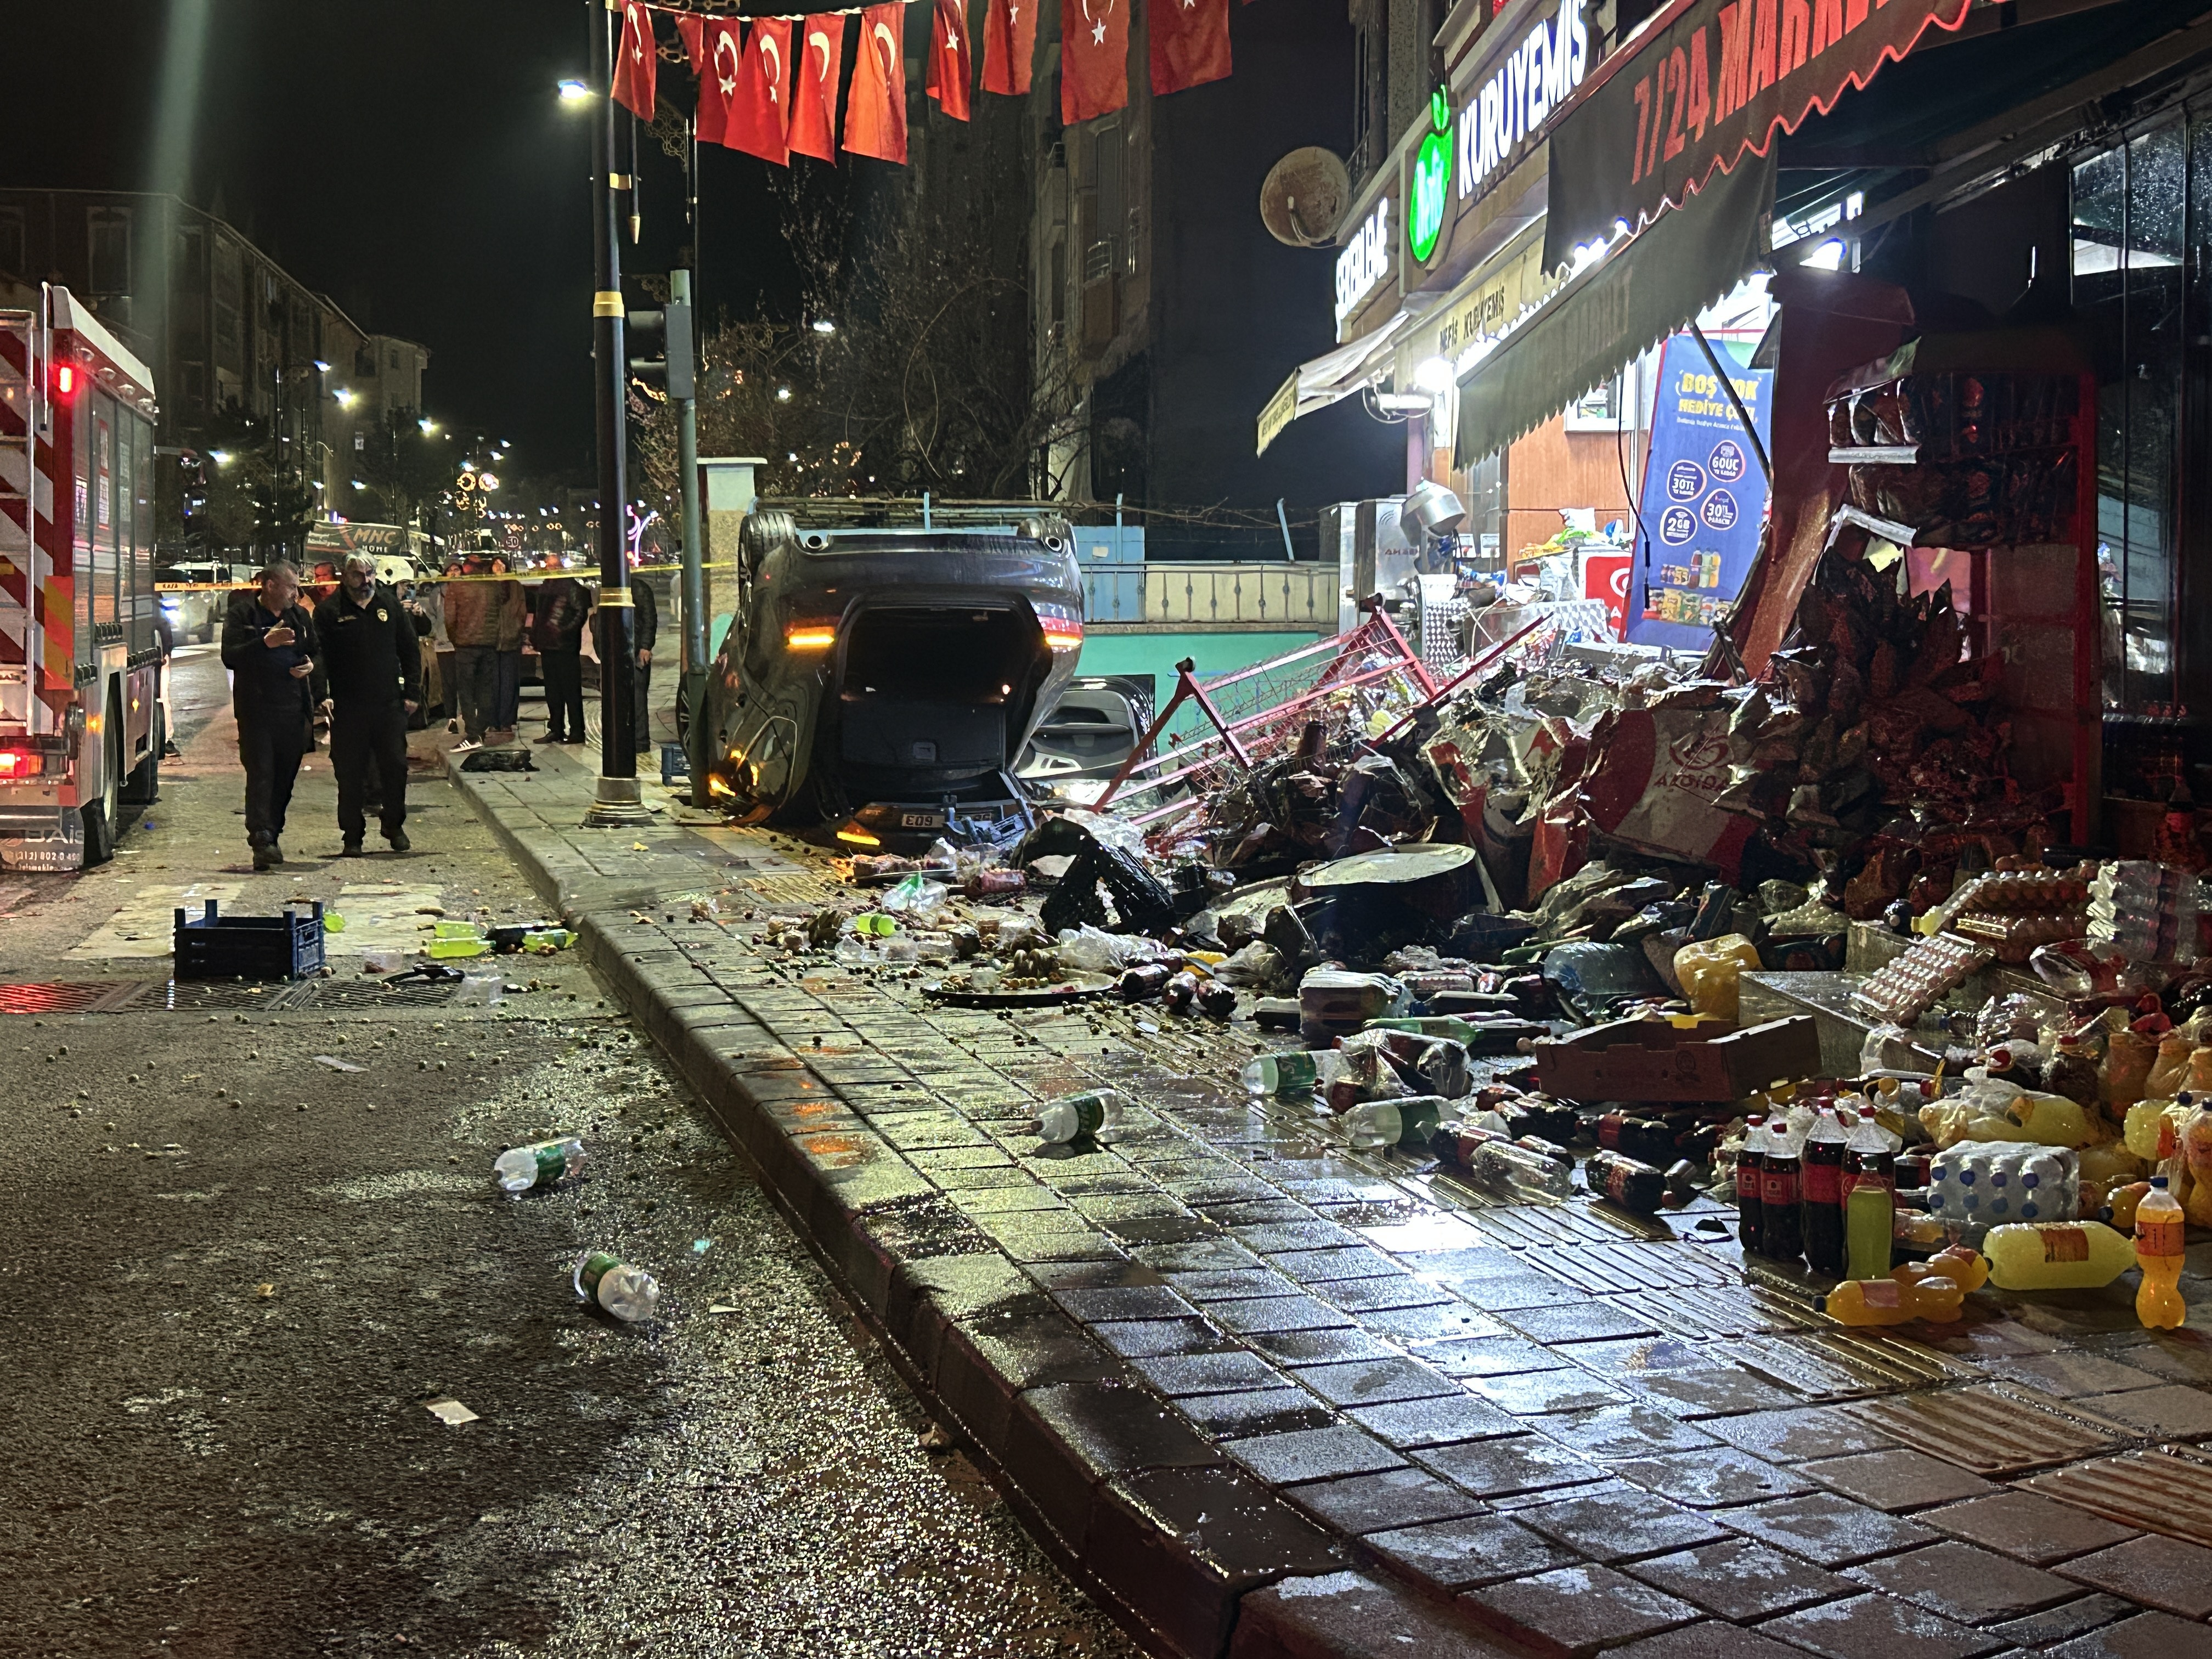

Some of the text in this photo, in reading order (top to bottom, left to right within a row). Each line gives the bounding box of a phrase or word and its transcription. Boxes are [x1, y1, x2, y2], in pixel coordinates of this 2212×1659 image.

[1632, 26, 1710, 185] 7/24
[1681, 373, 1718, 399] BOŞ
[1678, 399, 1724, 417] HEDİYE
[353, 528, 397, 544] MNC
